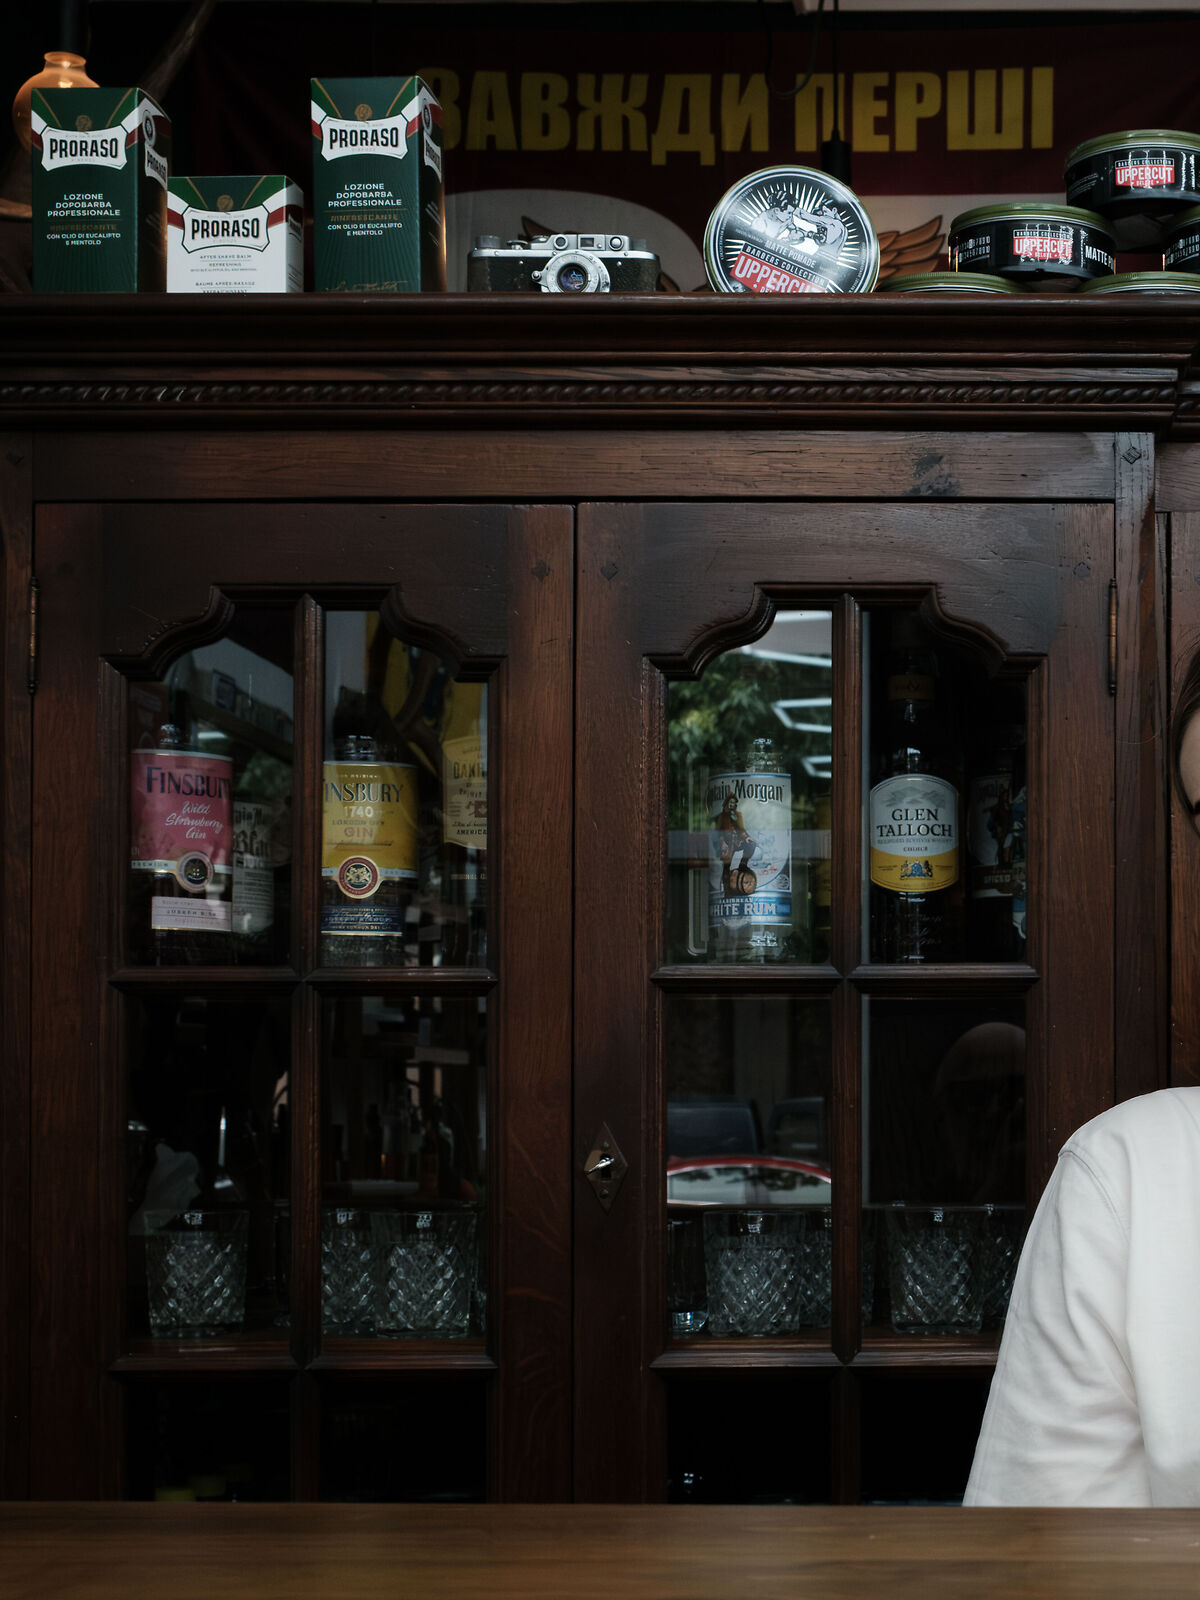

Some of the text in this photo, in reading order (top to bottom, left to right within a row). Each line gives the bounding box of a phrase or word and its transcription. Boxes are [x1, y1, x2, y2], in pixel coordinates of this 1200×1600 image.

[420, 67, 1054, 166] ЗАВЖДИ ПЕРШІ
[329, 127, 399, 150] PRORASO
[49, 137, 119, 160] PRORASO
[1116, 167, 1174, 185] UPPERCUT
[344, 183, 385, 191] LOZIONE
[63, 193, 104, 201] LOZIONE
[336, 191, 394, 200] DOPOBARBA
[55, 201, 112, 209] DOPOBARBA
[328, 199, 402, 208] PROFESSIONALE
[47, 209, 121, 217] PROFESSIONALE
[191, 217, 260, 241] PRORASO
[352, 229, 384, 237] MENTOLO
[367, 222, 403, 230] EUCALIPTO
[764, 240, 817, 268] MATTE POMADE
[1015, 238, 1070, 256] UPPERCUT
[1085, 245, 1107, 266] MATTE
[746, 246, 779, 265] BARBERS
[780, 262, 825, 286] COLLECTION
[734, 255, 827, 293] UPPERCU
[325, 782, 403, 803] INSBURY
[733, 779, 784, 803] Morgan
[182, 801, 211, 815] Wild
[344, 805, 374, 818] 1740
[891, 808, 938, 821] GLEN
[165, 812, 224, 834] Strawberry
[185, 827, 207, 840] Gin
[344, 826, 374, 838] GIN
[876, 824, 953, 838] TALLOCH
[711, 903, 777, 916] HITE RUM
